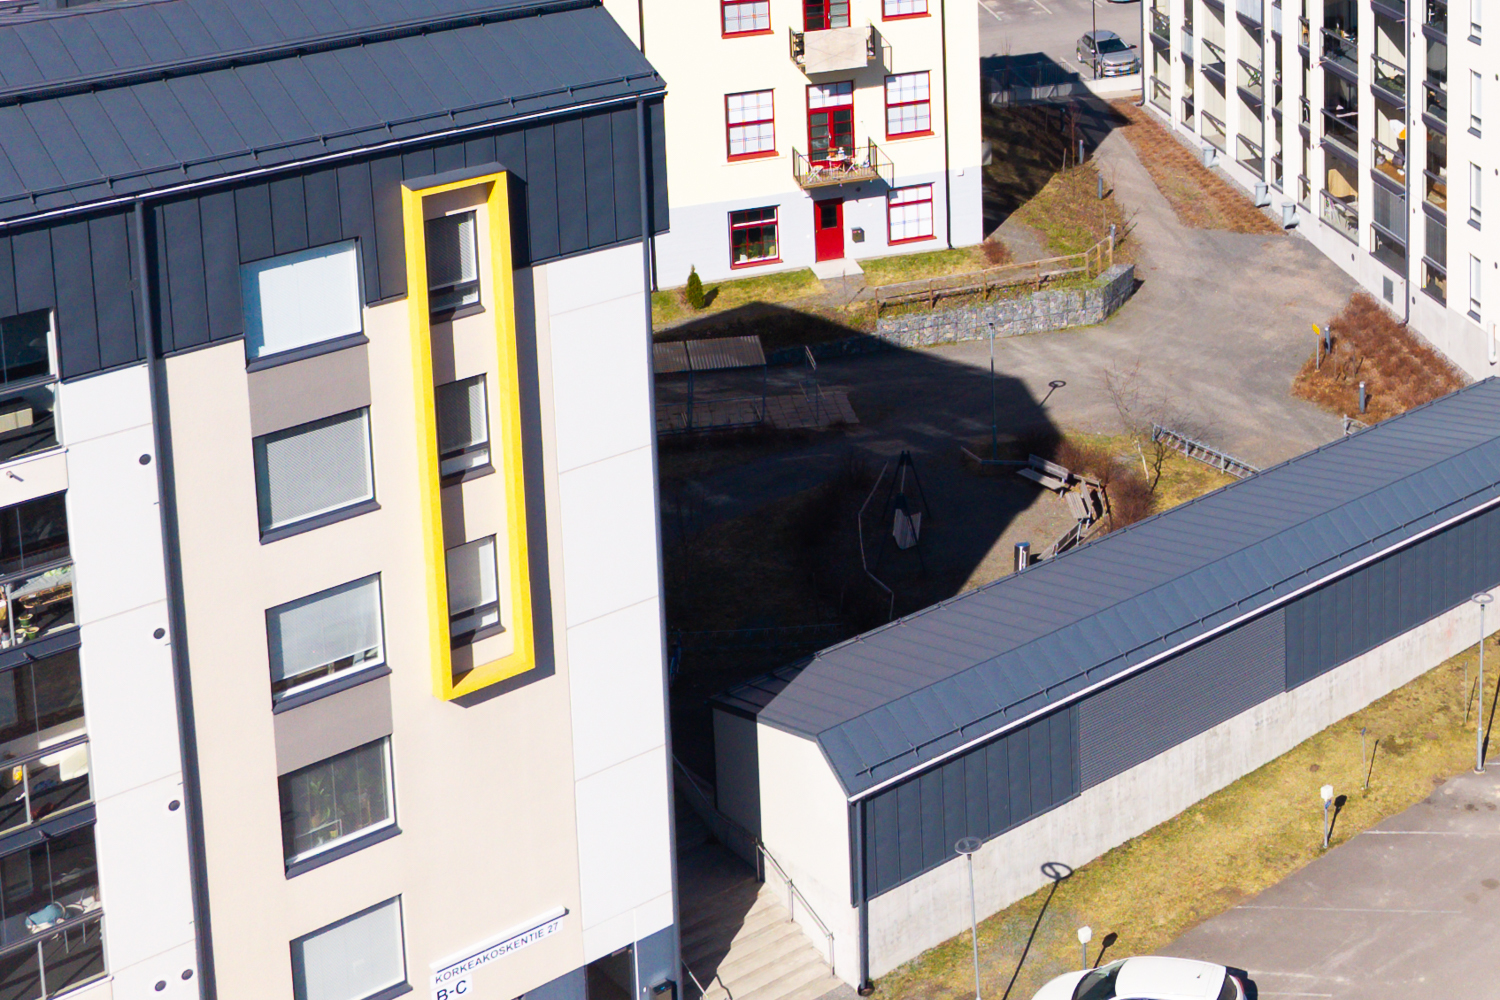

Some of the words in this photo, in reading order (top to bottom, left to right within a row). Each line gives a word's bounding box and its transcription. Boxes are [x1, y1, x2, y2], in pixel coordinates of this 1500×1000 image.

[435, 928, 545, 984] KORKEAKOSKENTIE
[547, 921, 559, 934] 27
[436, 979, 467, 1000] B-C
